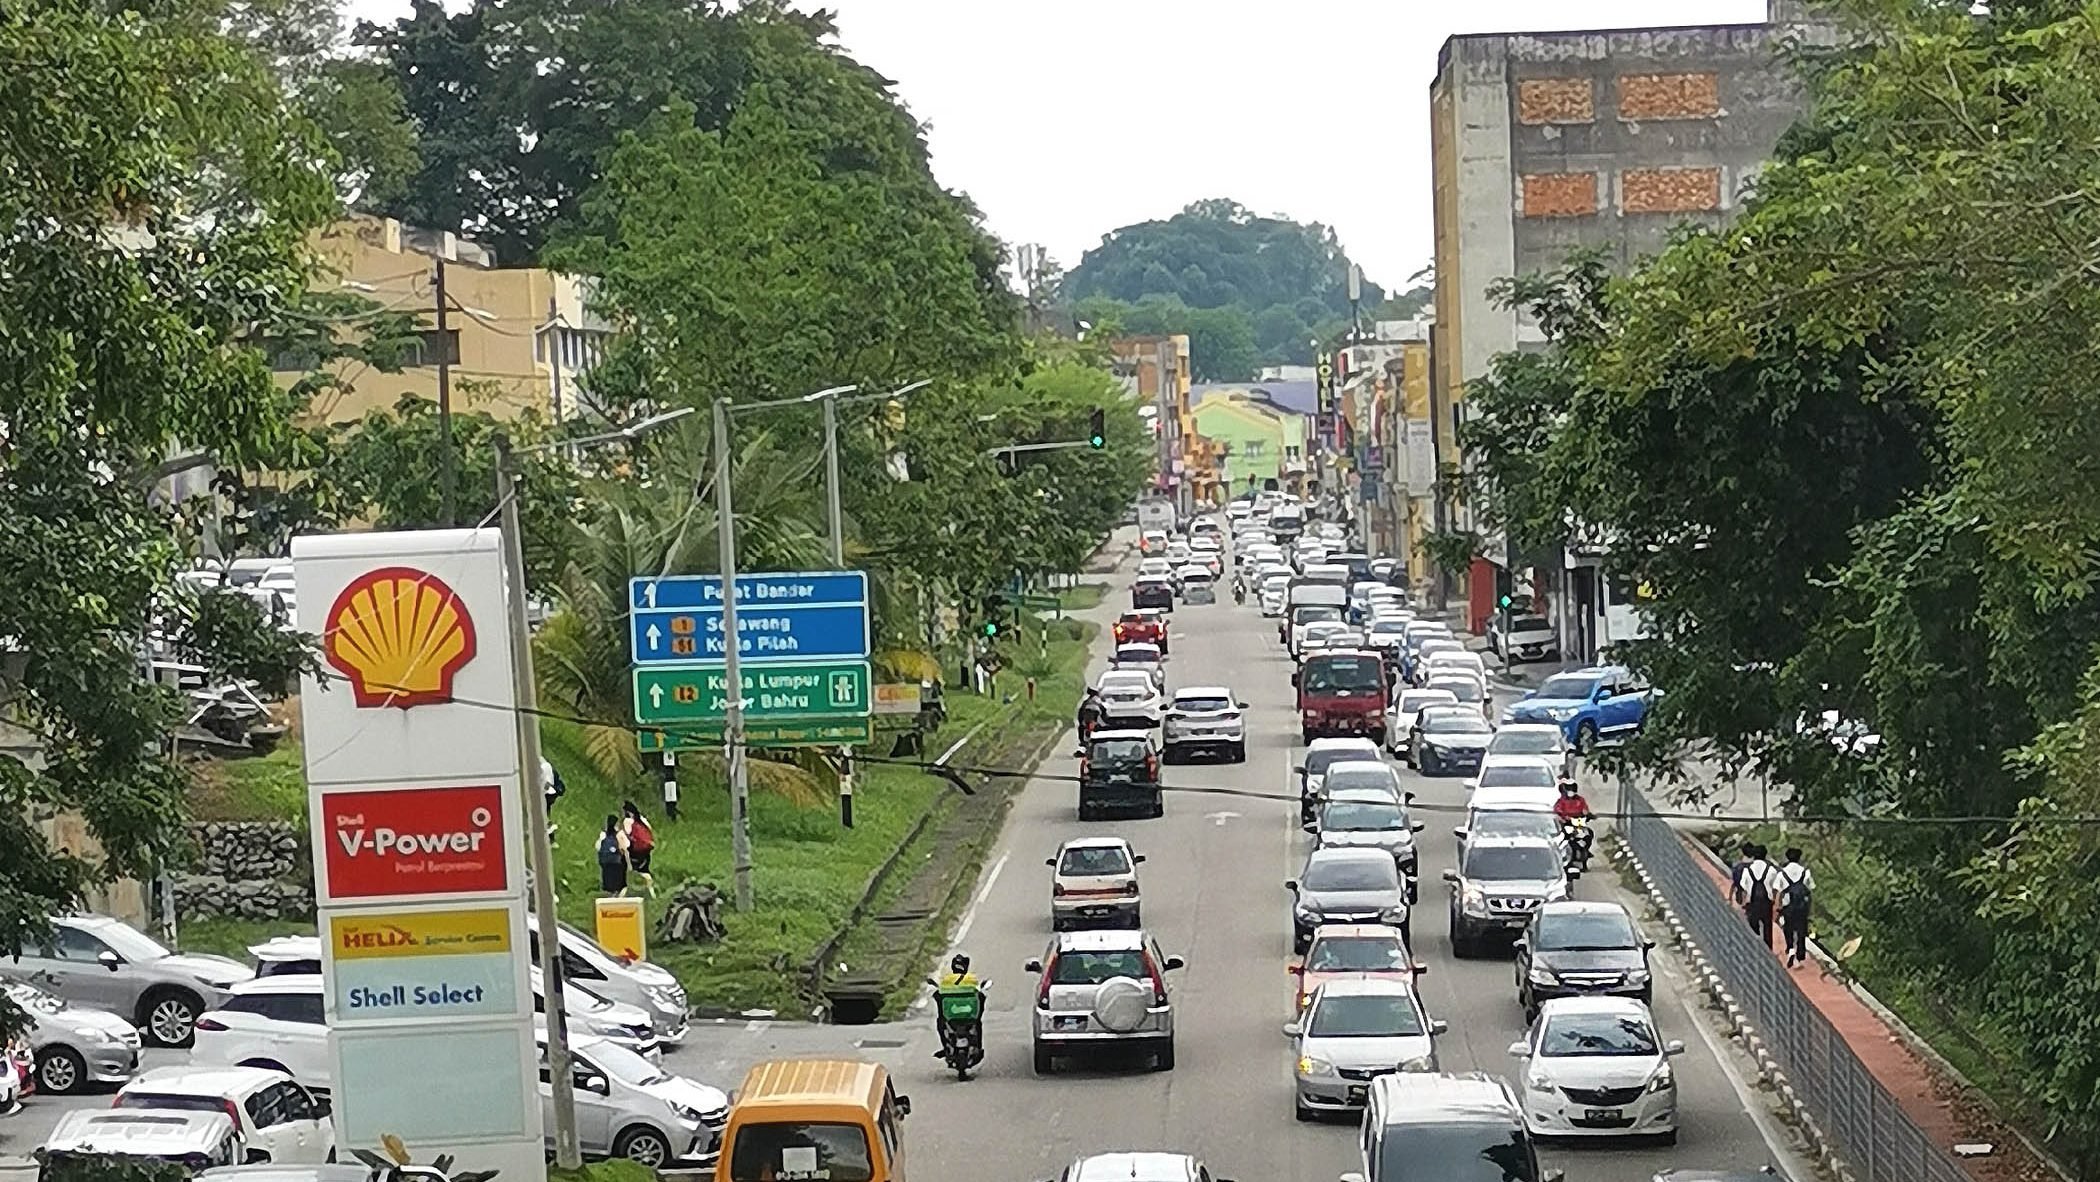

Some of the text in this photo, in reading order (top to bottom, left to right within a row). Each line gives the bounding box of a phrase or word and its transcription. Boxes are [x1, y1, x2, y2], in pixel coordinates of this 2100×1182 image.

[704, 582, 814, 600] Puat Bandar
[706, 617, 791, 632] Seawang
[706, 636, 798, 652] Kula Pilah
[759, 673, 820, 690] Lumpur
[761, 693, 809, 709] Bahru
[337, 827, 486, 857] V-Power
[343, 930, 418, 948] HELIX
[350, 982, 484, 1008] Shell Select
